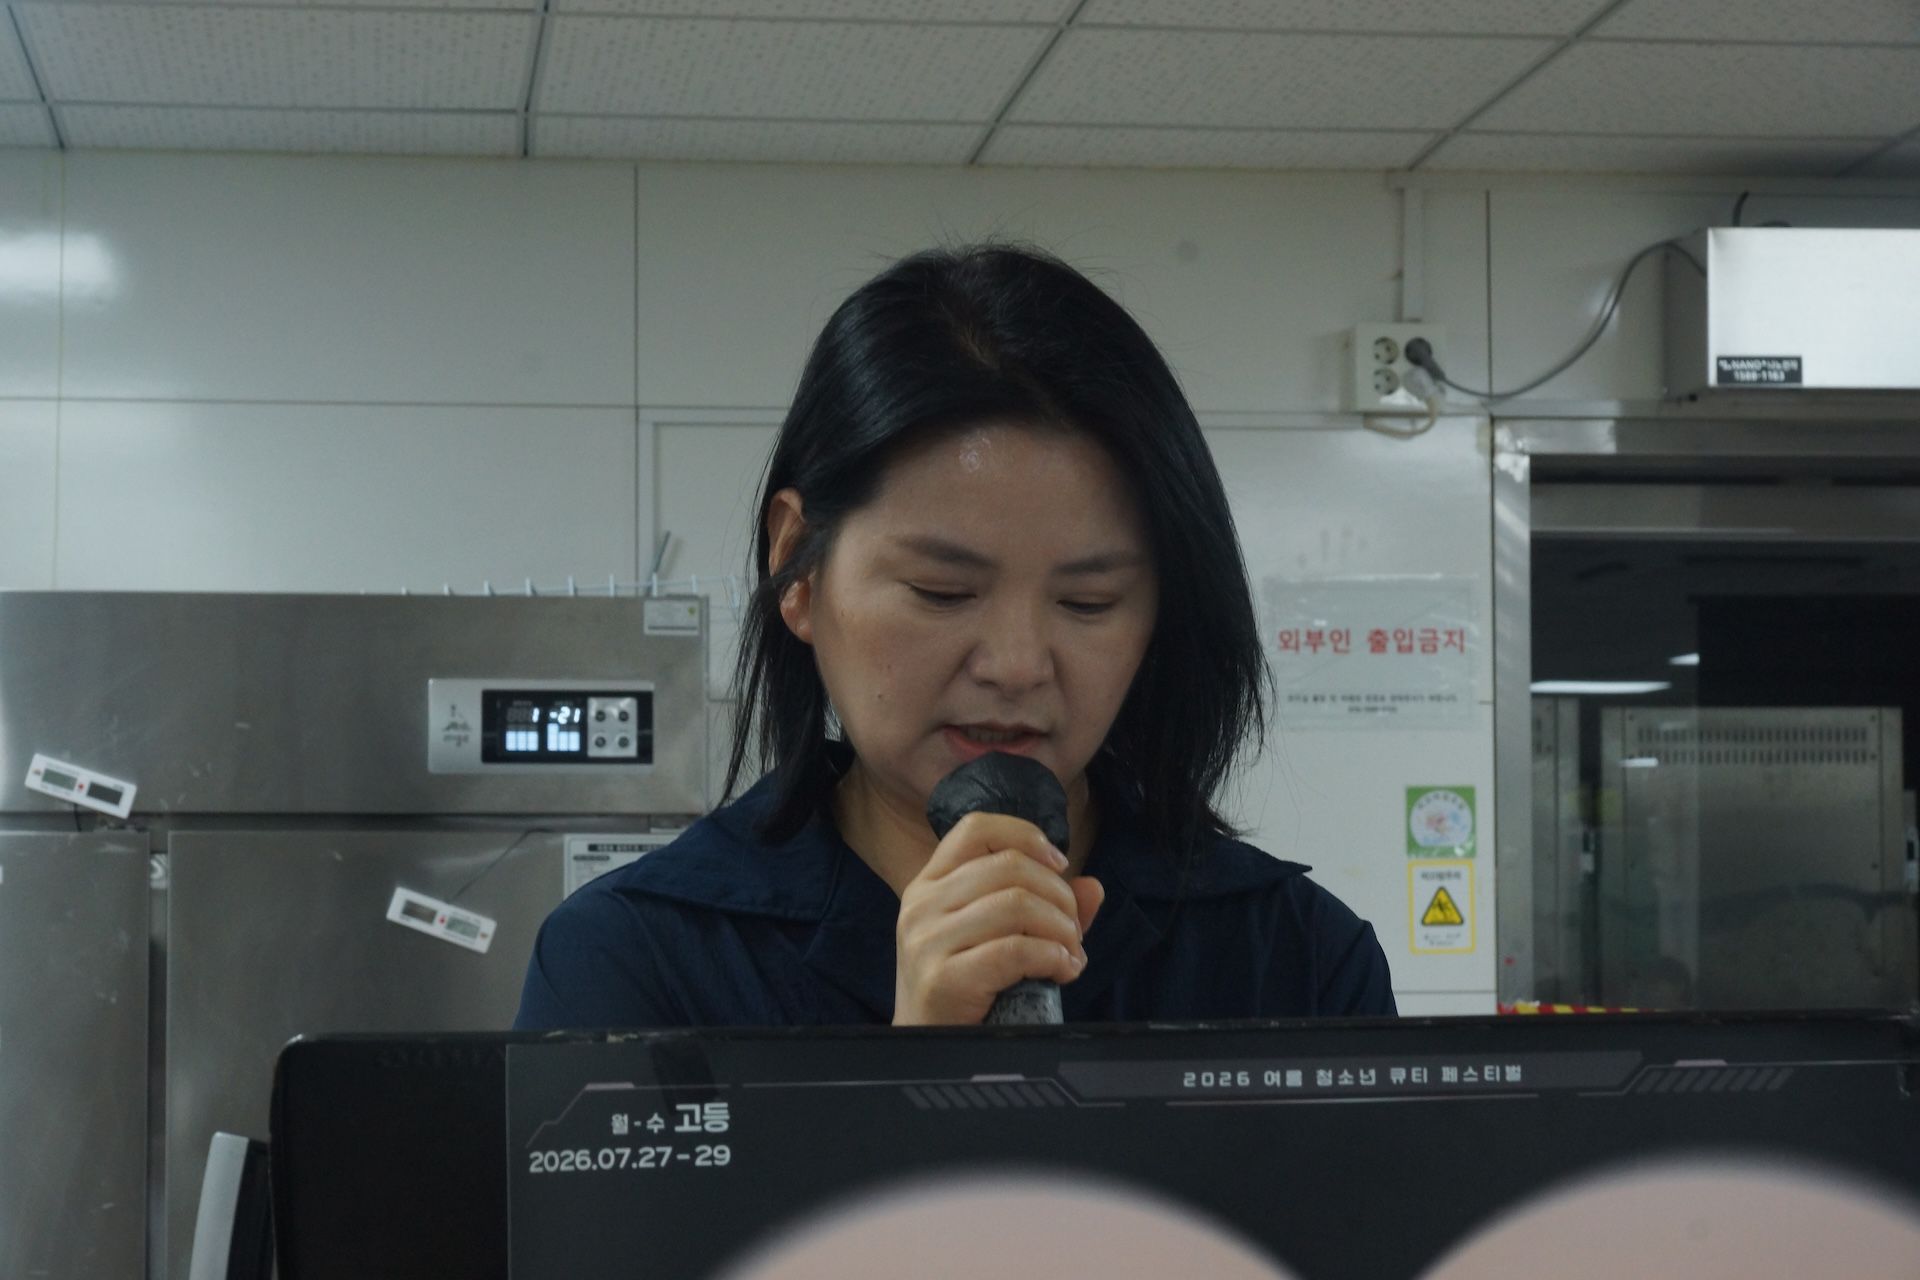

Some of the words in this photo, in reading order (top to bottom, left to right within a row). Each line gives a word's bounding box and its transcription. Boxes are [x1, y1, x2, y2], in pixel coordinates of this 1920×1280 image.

[1278, 628, 1351, 654] 외부인
[1367, 628, 1465, 654] 출입금지
[1183, 1071, 1250, 1088] 2026
[1316, 1068, 1377, 1087] 청소년
[1389, 1066, 1428, 1085] 큐티
[1441, 1064, 1522, 1084] 페스티벌
[674, 1102, 731, 1133] 고등
[528, 1144, 732, 1173] 2026.07.27-29
